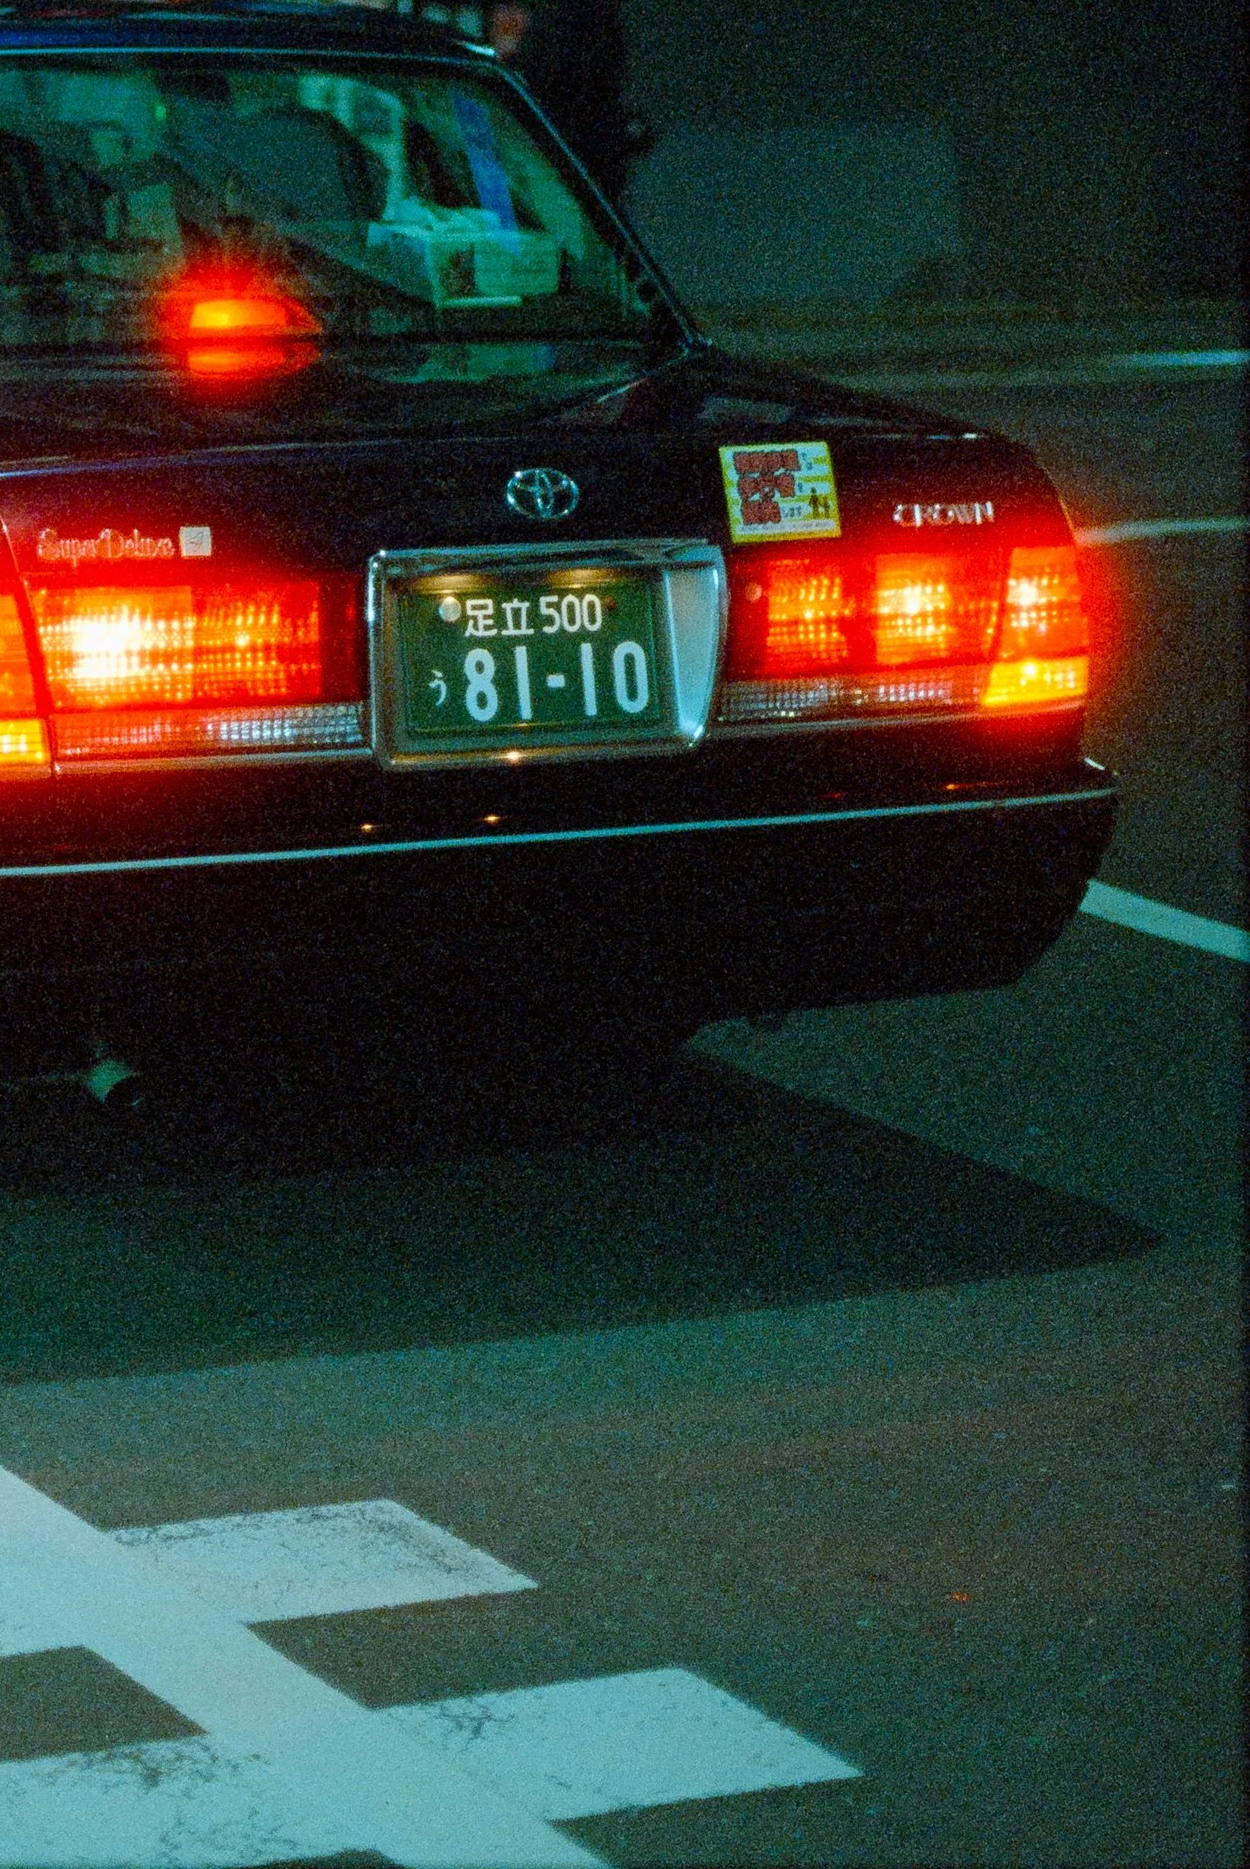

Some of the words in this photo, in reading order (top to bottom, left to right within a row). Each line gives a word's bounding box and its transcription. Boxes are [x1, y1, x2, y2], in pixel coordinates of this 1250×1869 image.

[892, 501, 996, 528] CROWN
[428, 669, 448, 708] う
[464, 640, 649, 723] 81-10
